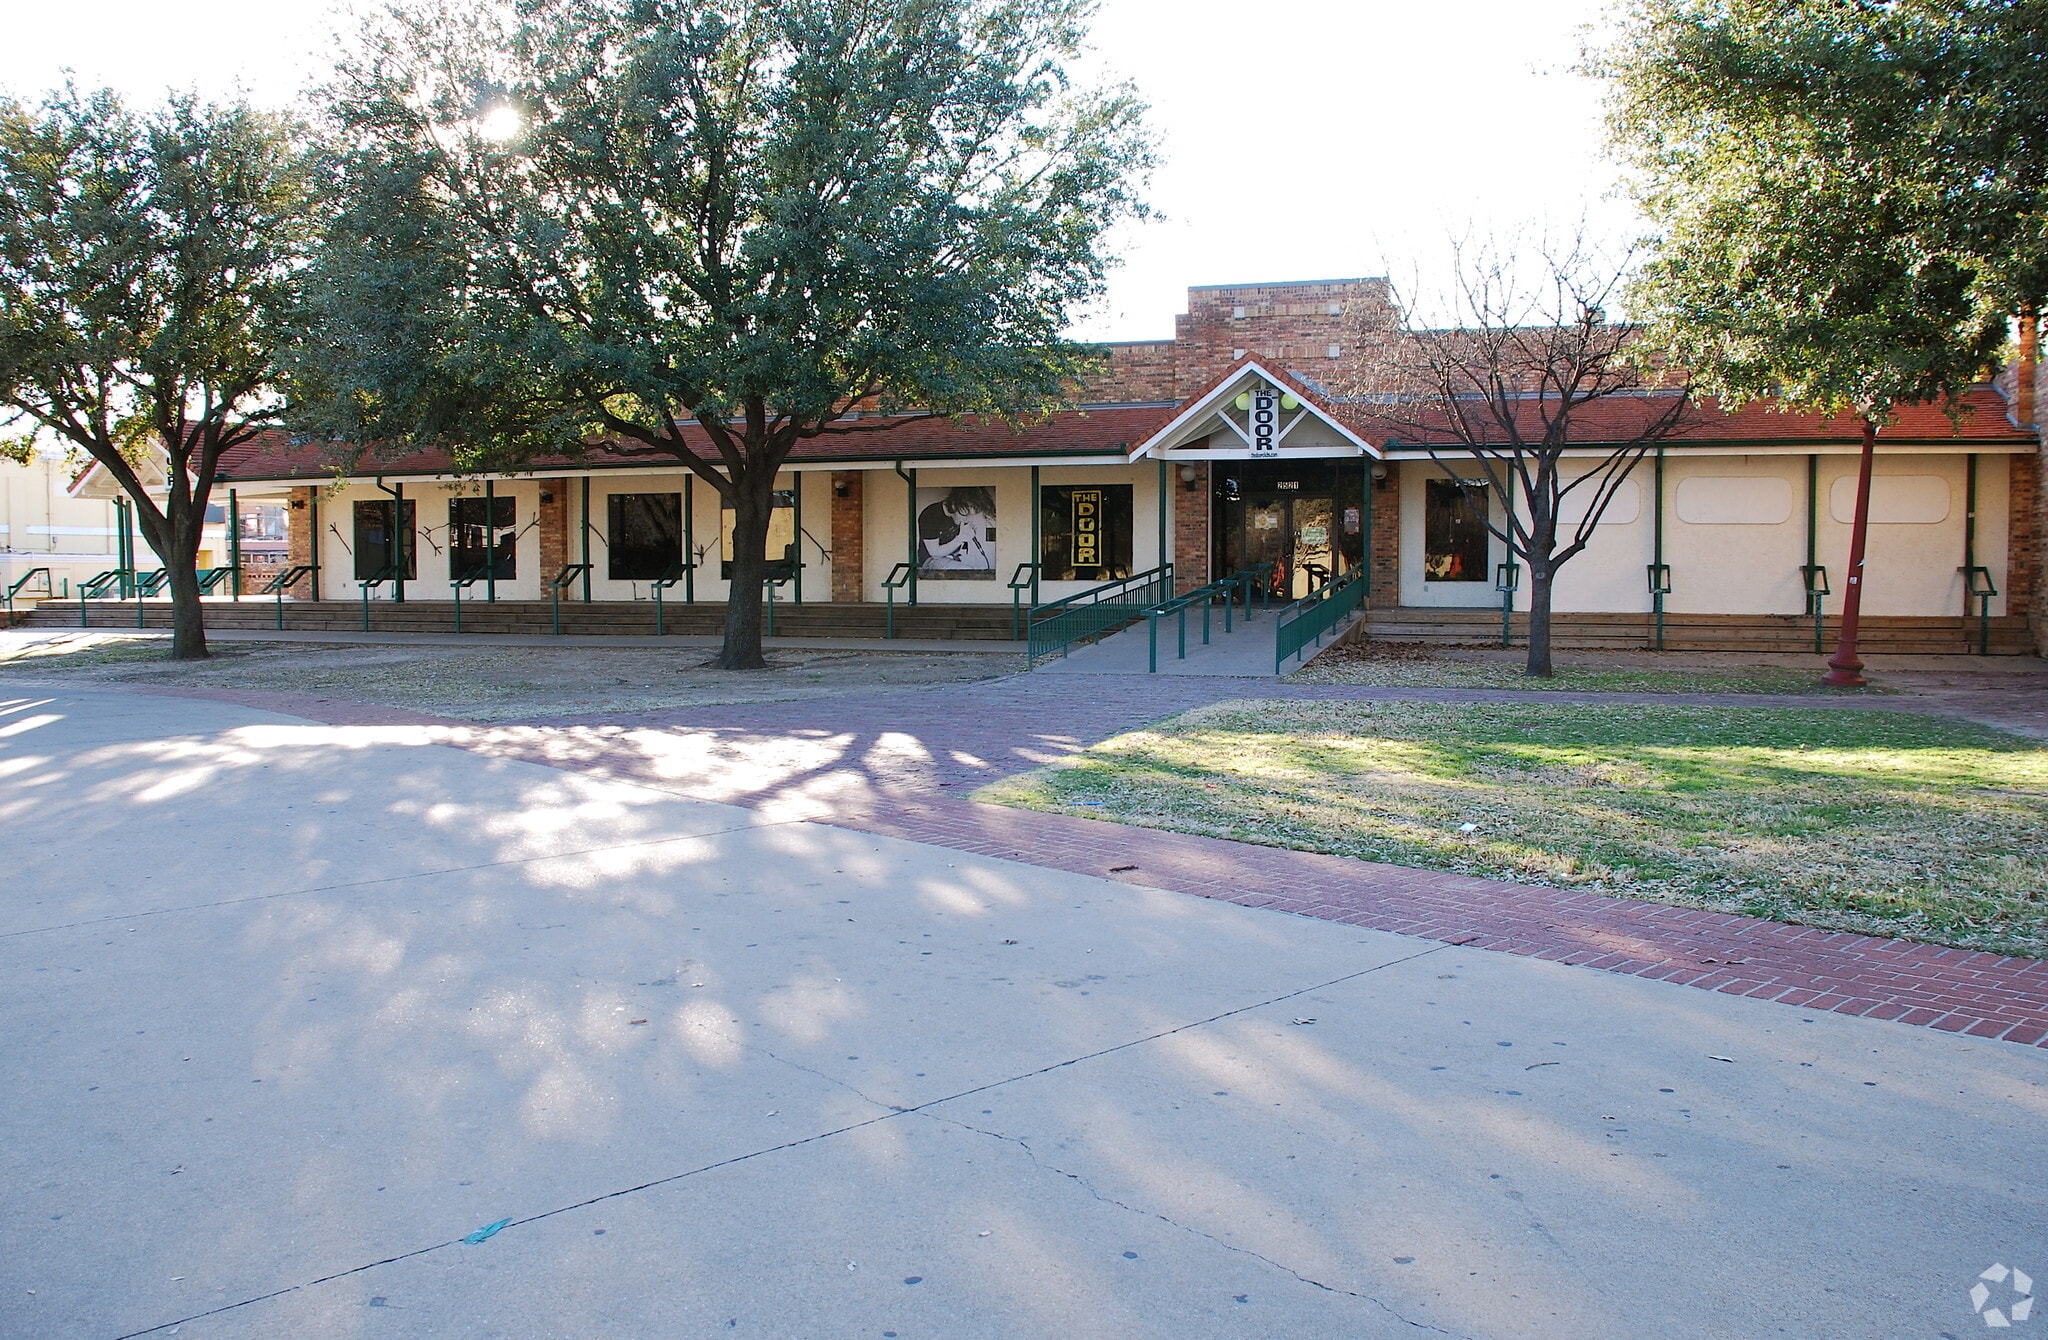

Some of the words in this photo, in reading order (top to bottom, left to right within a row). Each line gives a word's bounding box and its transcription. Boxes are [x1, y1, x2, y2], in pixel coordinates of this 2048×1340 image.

[1255, 397, 1273, 450] DOOR
[1074, 493, 1097, 502] THE
[1078, 503, 1095, 562] DOOR
